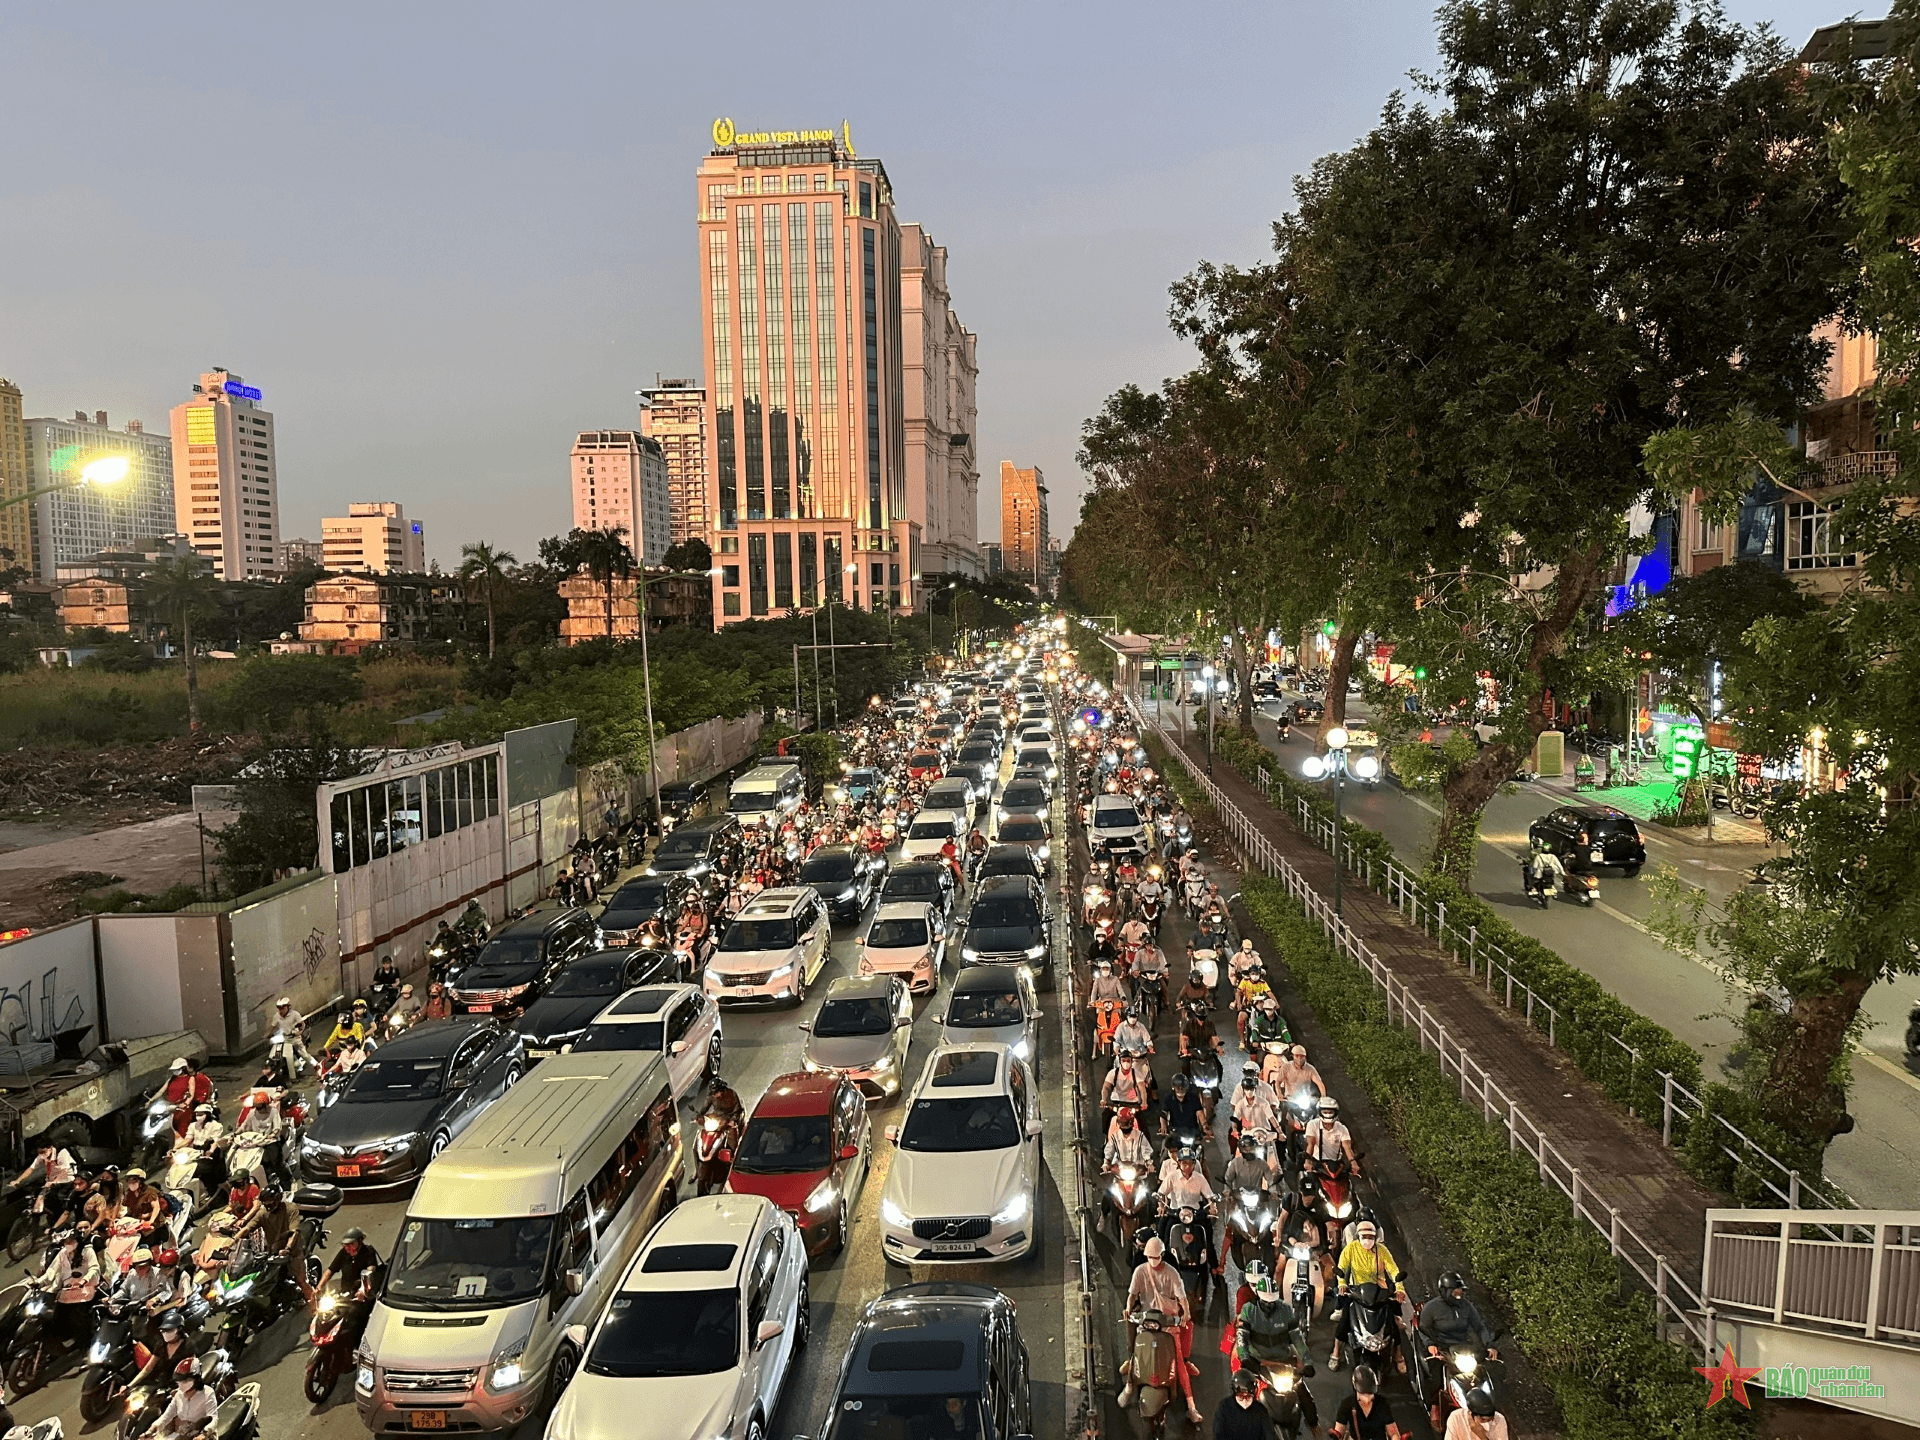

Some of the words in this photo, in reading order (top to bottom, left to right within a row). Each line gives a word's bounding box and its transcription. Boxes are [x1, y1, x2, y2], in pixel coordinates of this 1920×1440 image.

[735, 132, 770, 144] GRAND
[771, 131, 799, 143] VISTA
[800, 129, 833, 141] HANOI
[465, 1284, 477, 1296] 11
